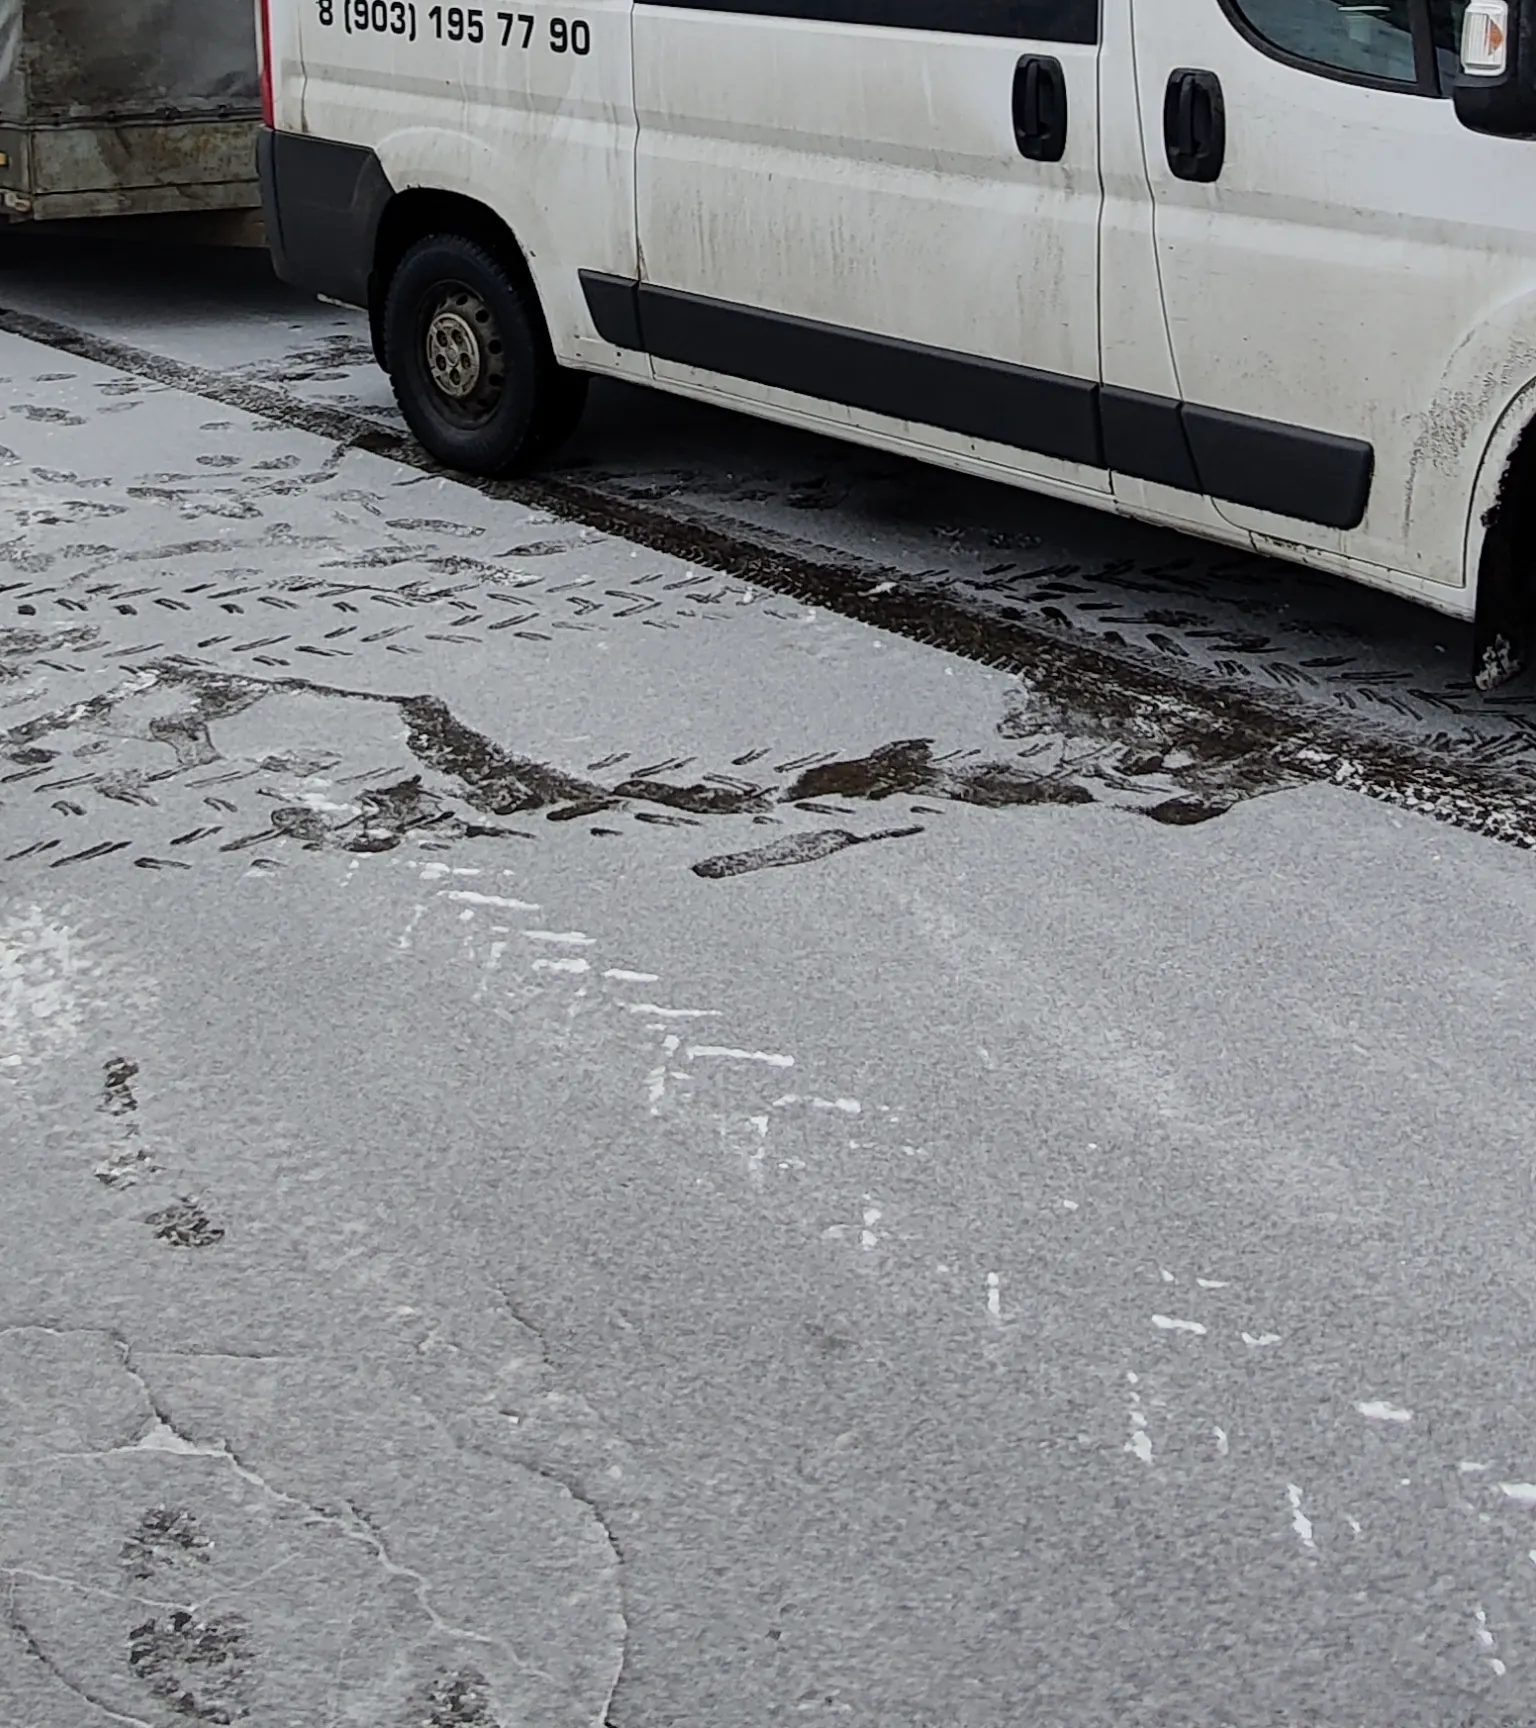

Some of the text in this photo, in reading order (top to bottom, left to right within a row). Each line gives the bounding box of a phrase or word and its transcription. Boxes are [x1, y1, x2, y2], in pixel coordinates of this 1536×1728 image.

[428, 6, 484, 44] 195
[497, 12, 534, 49] 77
[549, 17, 591, 56] 90
